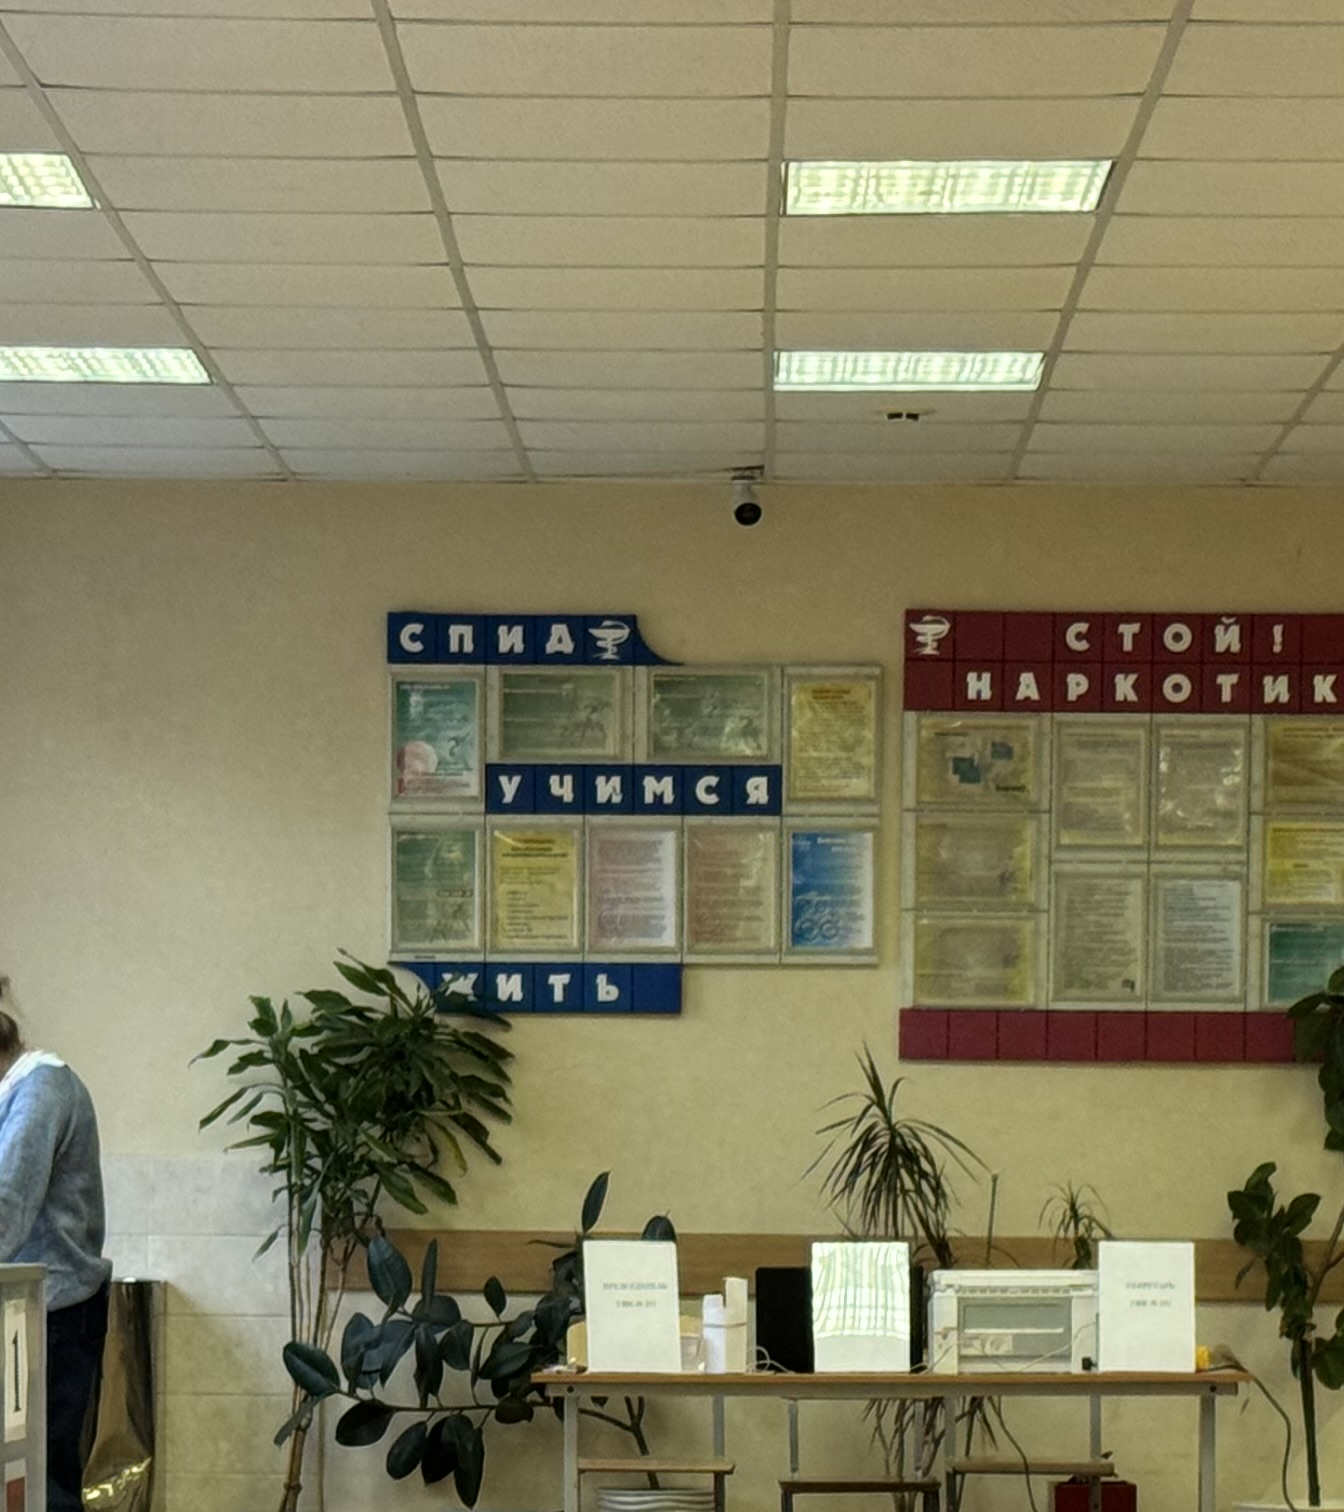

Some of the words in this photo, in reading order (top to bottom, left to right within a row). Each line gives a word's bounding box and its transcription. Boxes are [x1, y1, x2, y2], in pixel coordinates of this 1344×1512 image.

[399, 623, 576, 654] СПИД
[1065, 616, 1285, 654] СТОЙ!
[966, 672, 1338, 703] НАРКОТИК
[499, 775, 769, 805] УЧИМСЯ
